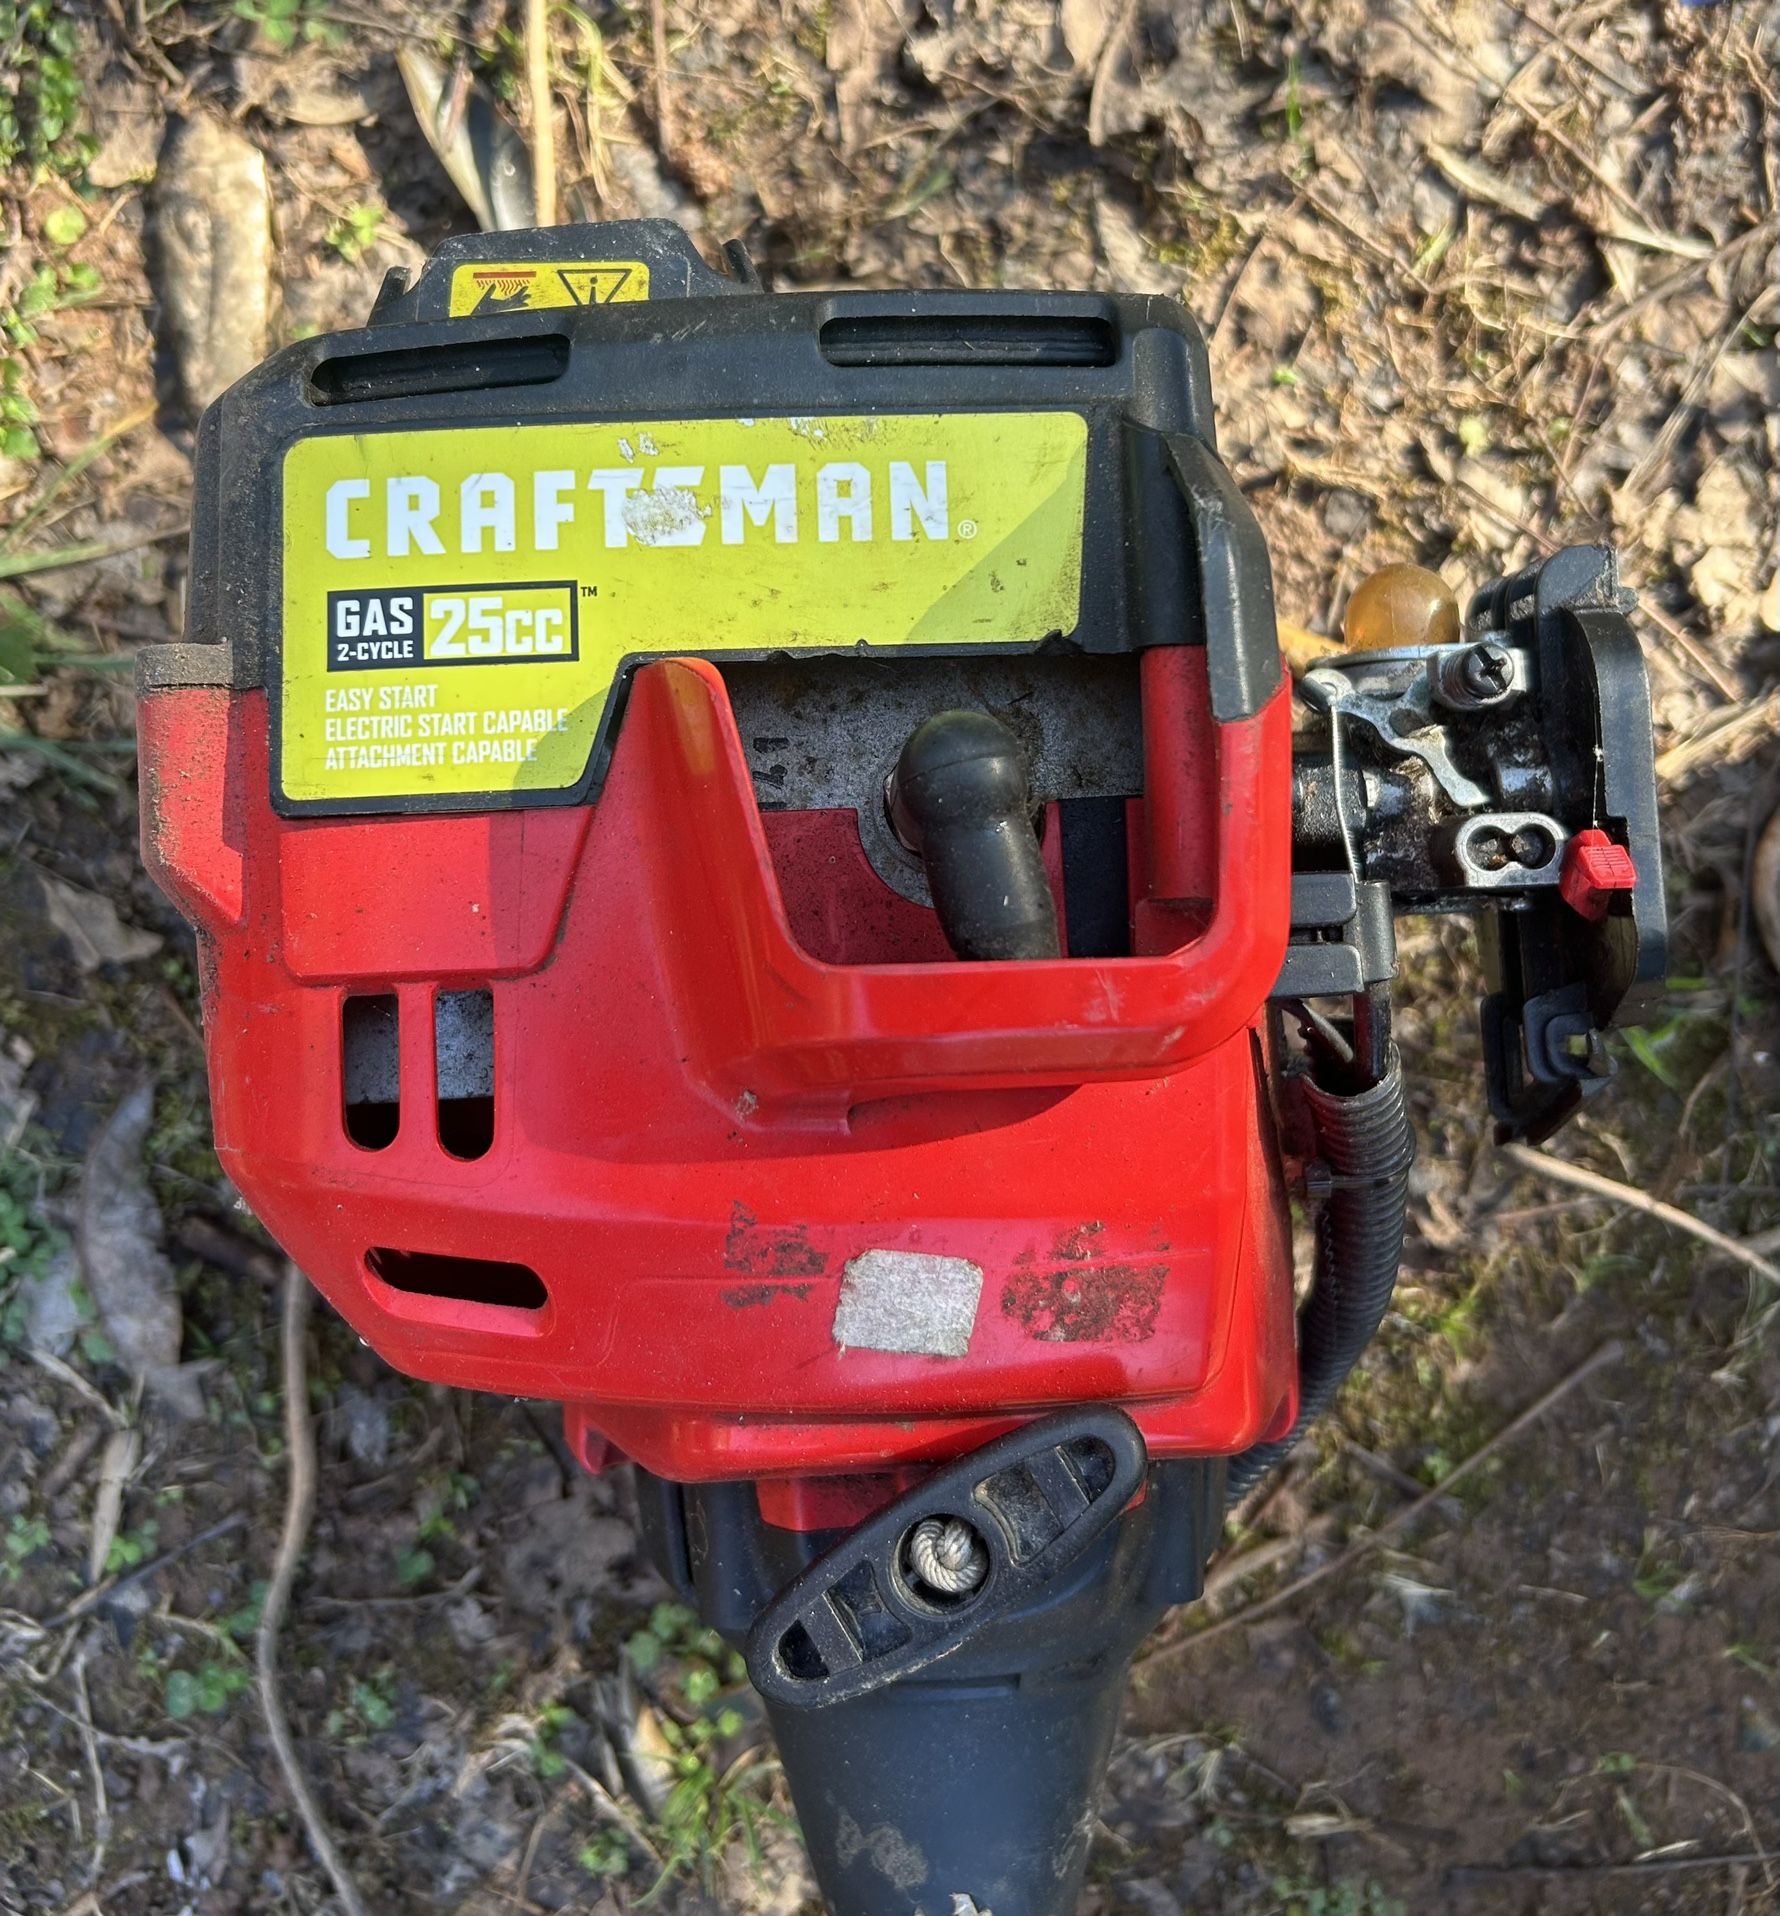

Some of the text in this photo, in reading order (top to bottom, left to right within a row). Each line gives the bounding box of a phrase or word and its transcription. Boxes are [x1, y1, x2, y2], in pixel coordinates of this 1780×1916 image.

[326, 461, 949, 559] CRAFTSMAN
[336, 597, 414, 637] GAS
[337, 640, 414, 661] 2-CYCLE
[325, 684, 438, 712] EASY START
[325, 708, 569, 741] ELECTRIC START CAPABLE
[324, 738, 538, 770] ATTACHMENT CAPABLE
